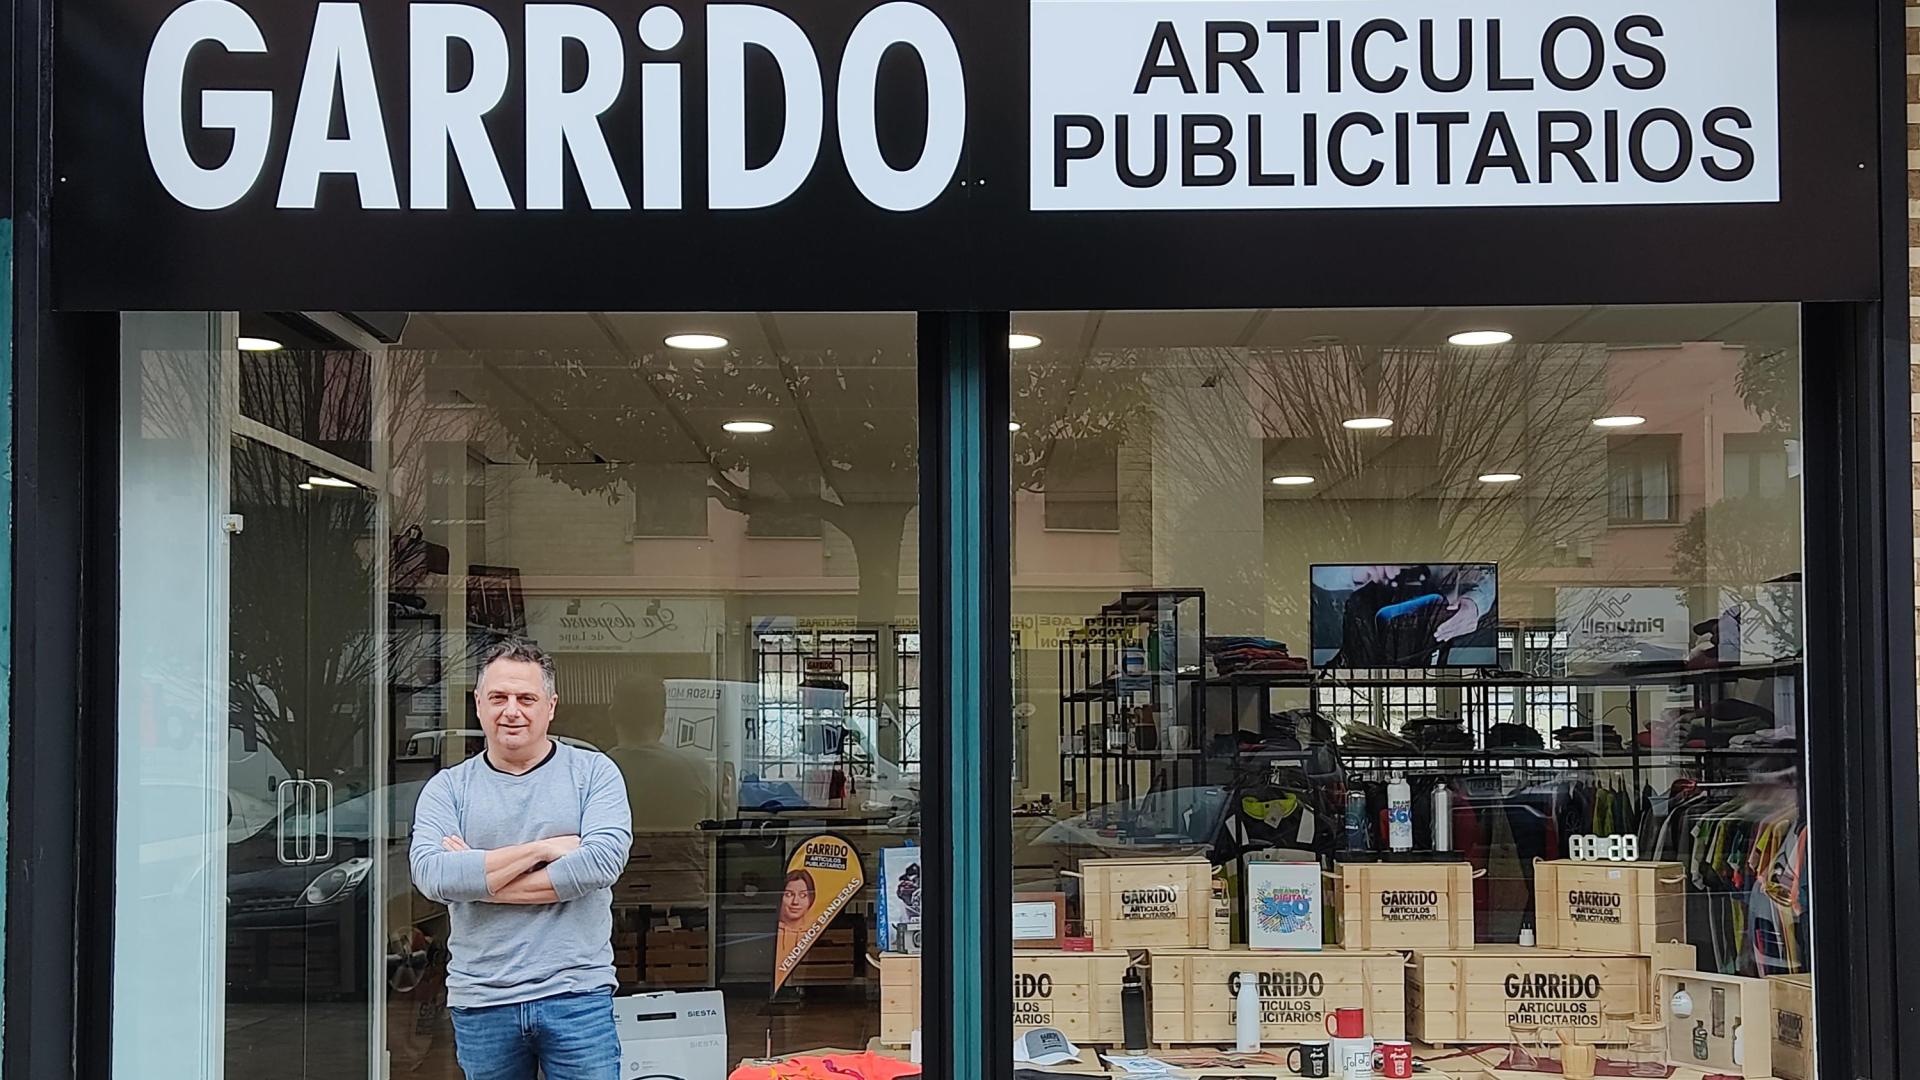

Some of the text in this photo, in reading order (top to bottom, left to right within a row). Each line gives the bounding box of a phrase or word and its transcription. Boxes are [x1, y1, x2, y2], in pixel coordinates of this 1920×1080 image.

[1133, 15, 1666, 94] ARTICULOS
[143, 0, 966, 211] GARRiDO
[1053, 107, 1756, 188] PUBLICITARIOS
[1263, 897, 1310, 917] 360
[779, 878, 860, 972] VENDEMOS BANDERAS
[1228, 971, 1324, 997] GRRiDO
[1504, 973, 1601, 998] GARRiDO
[687, 1009, 718, 1018] SIESTA
[1260, 1001, 1311, 1011] TICULOS
[1518, 1002, 1587, 1013] ARTICULOS
[1508, 1014, 1598, 1026] PUBLICITARIOS
